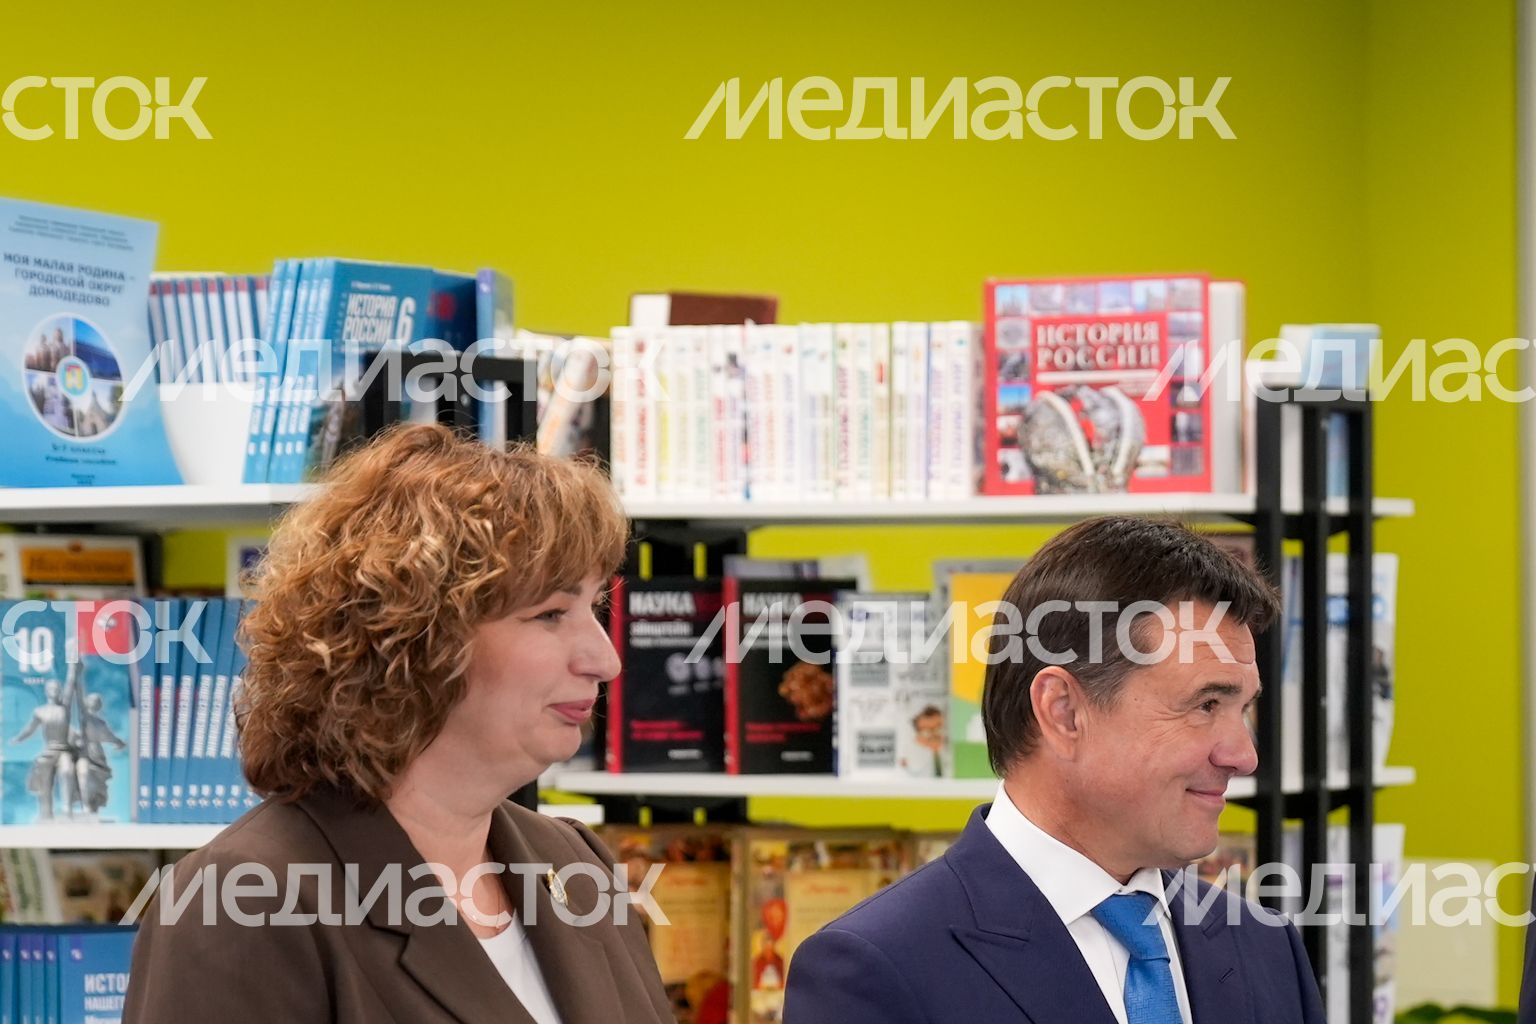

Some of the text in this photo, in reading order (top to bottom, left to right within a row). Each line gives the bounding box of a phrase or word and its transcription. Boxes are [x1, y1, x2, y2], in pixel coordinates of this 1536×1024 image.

[4, 253, 29, 266] МОЯ
[33, 257, 74, 273] МАЛАЯ
[78, 264, 125, 281] РОДИНА
[15, 267, 125, 294] ГОРОДСКОЙ ОКРУГ
[29, 284, 110, 306] ДОМОДЕДОВО
[346, 293, 398, 318] ИСТОРИЯ
[342, 316, 396, 343] РОССИИ
[396, 297, 416, 346] 6
[1036, 320, 1160, 346] ИСТОРИЯ
[1036, 344, 1160, 370] РОССИИ
[15, 627, 53, 673] 10
